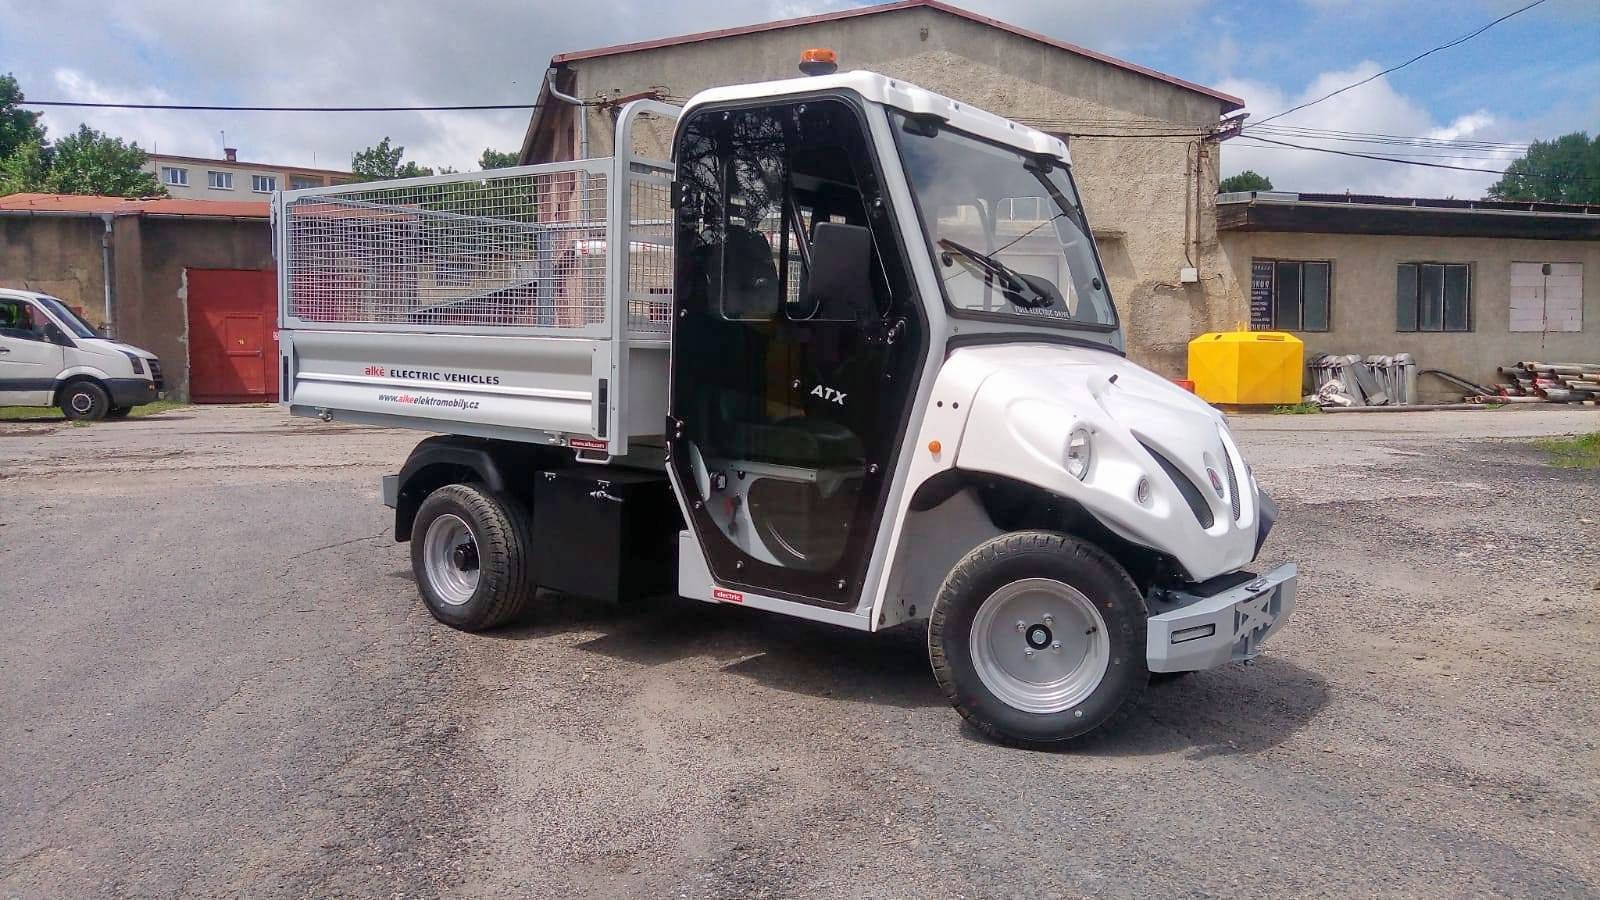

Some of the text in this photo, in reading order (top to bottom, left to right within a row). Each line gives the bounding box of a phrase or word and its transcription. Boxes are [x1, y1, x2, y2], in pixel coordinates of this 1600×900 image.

[390, 369, 441, 381] ELECTRIC
[443, 373, 500, 385] VEHICLES
[378, 394, 480, 410] www.alkeelektromobily.cz
[810, 384, 848, 405] ATX
[716, 591, 742, 601] electric
